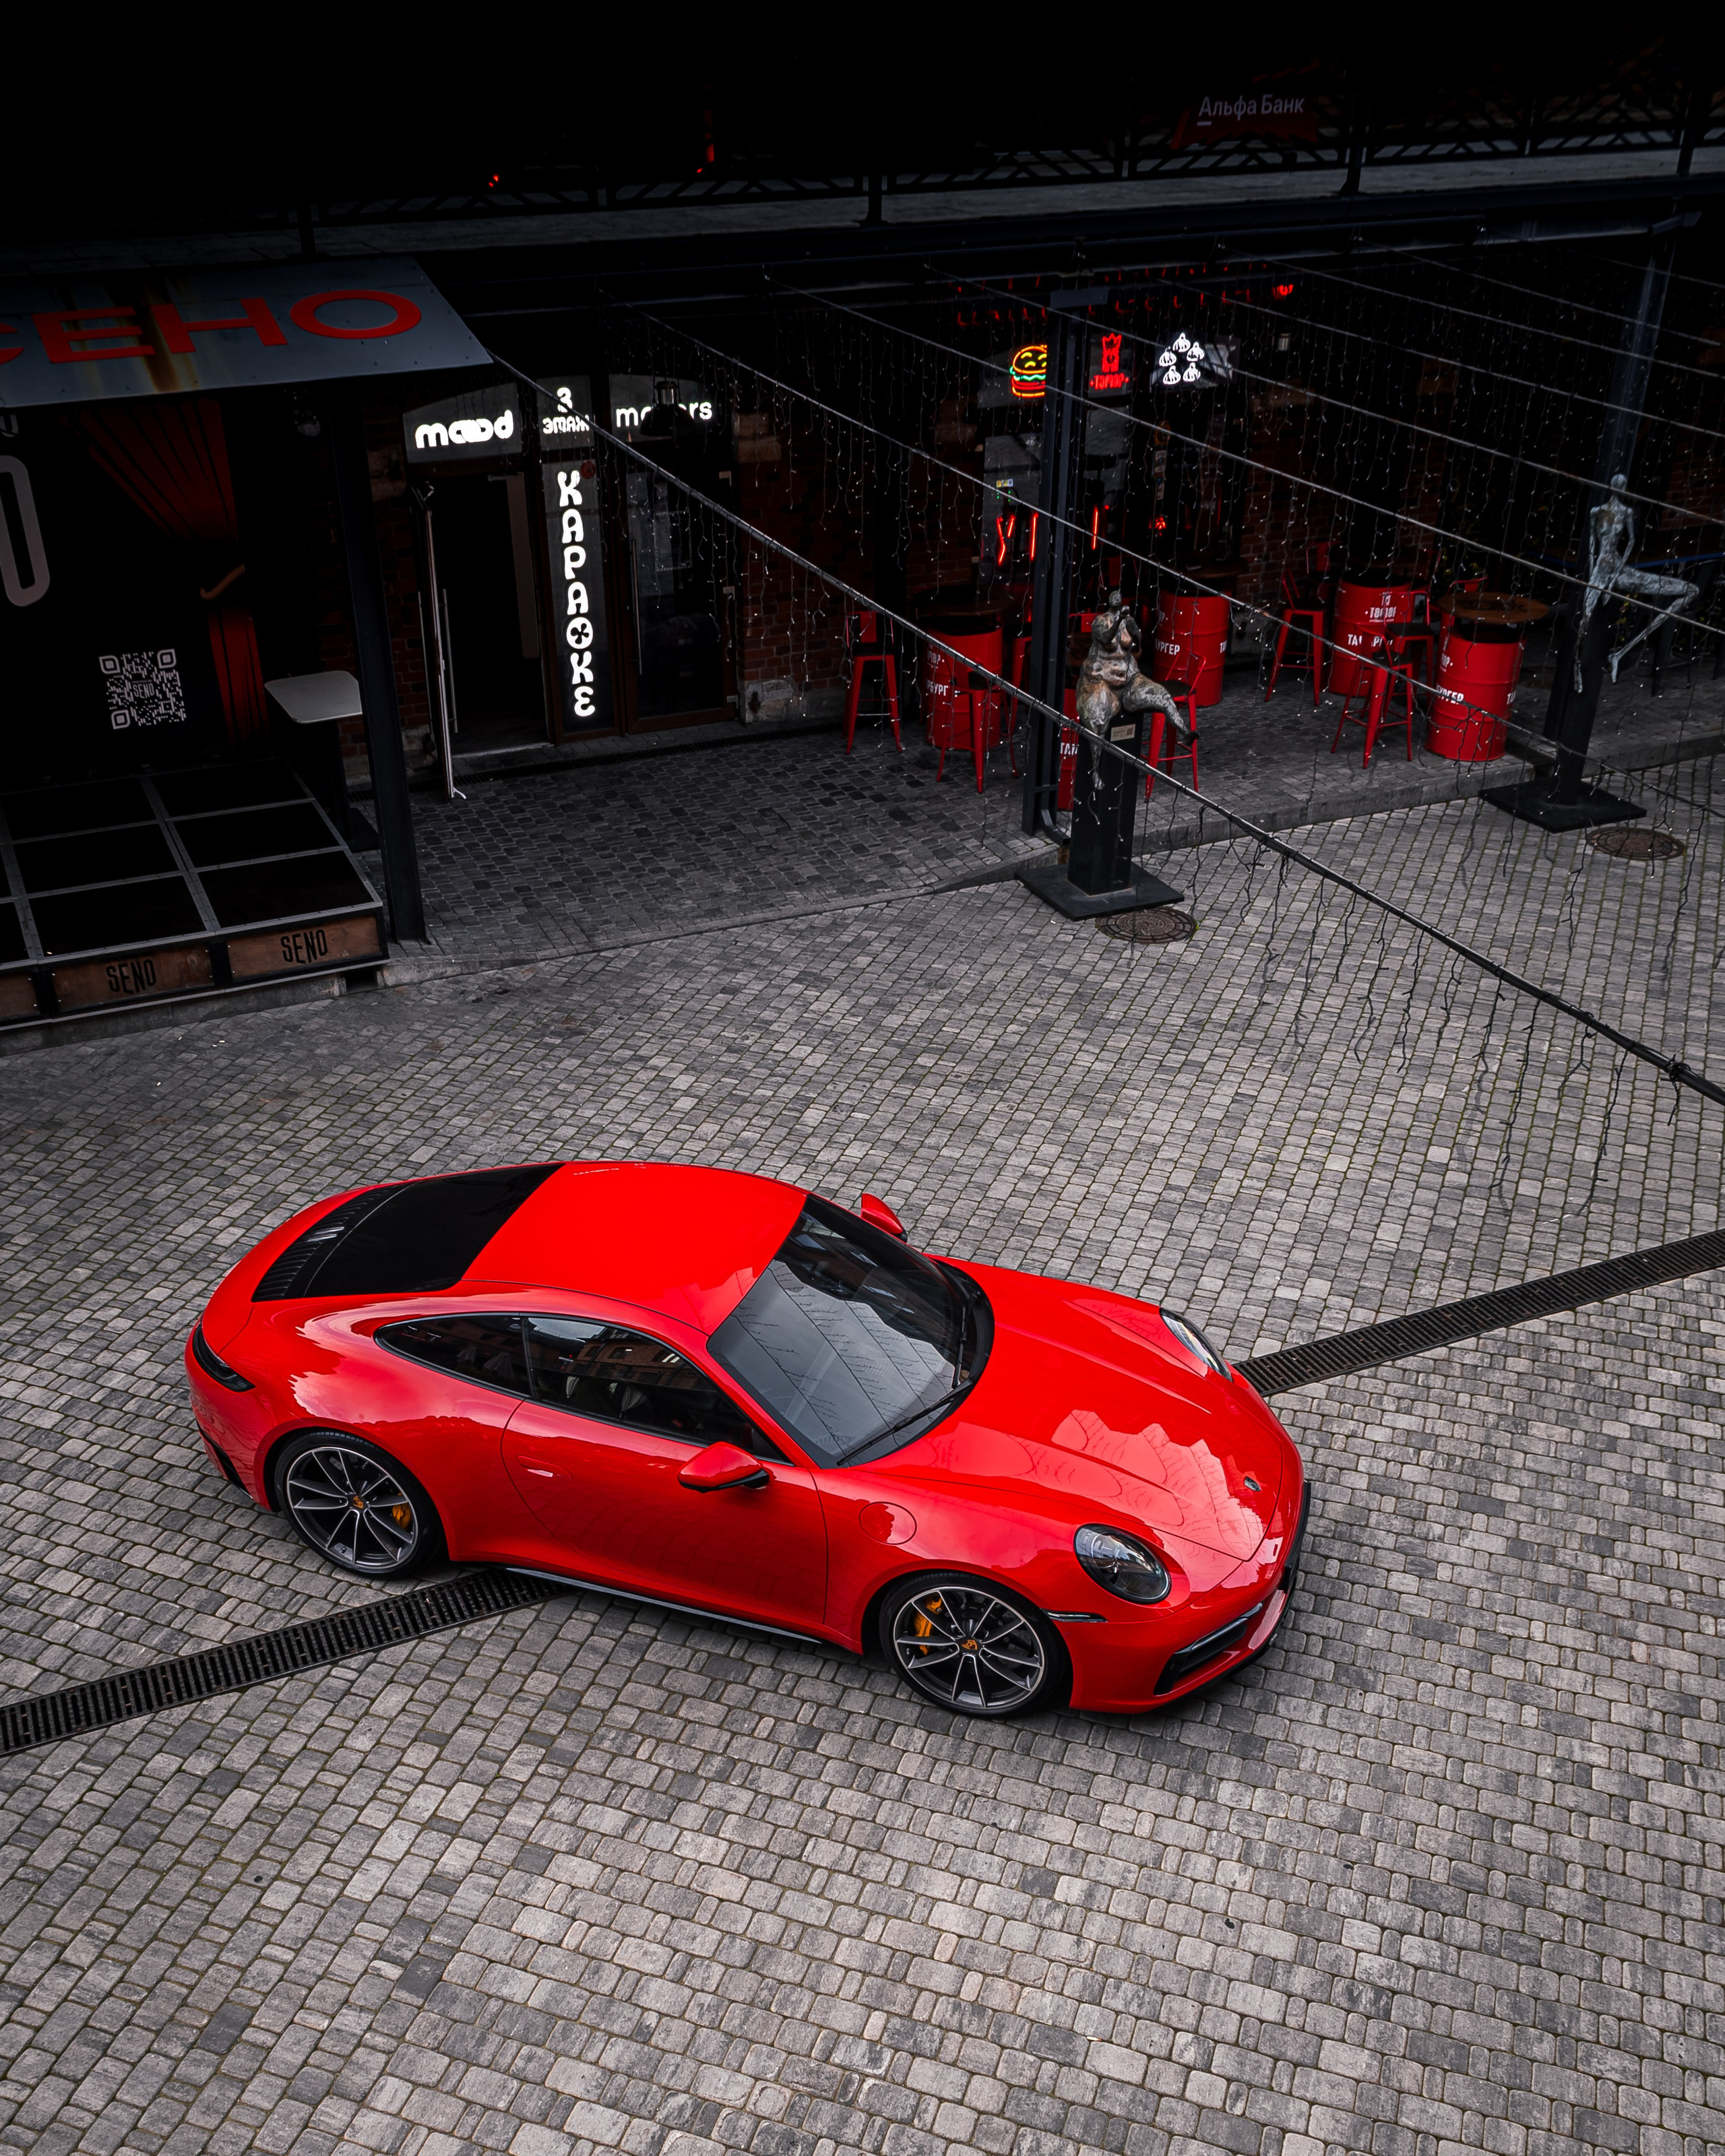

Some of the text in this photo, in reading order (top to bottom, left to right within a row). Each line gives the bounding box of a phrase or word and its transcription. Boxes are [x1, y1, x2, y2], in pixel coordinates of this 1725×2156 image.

[1197, 92, 1305, 122] Альфа Банк
[0, 290, 422, 365] ЕНО
[557, 387, 573, 412] 3
[415, 409, 514, 449] mood
[557, 469, 596, 718] КАРАОКЕ
[133, 683, 155, 699] SENO
[280, 929, 328, 965] SENO
[106, 959, 157, 994] SENO
